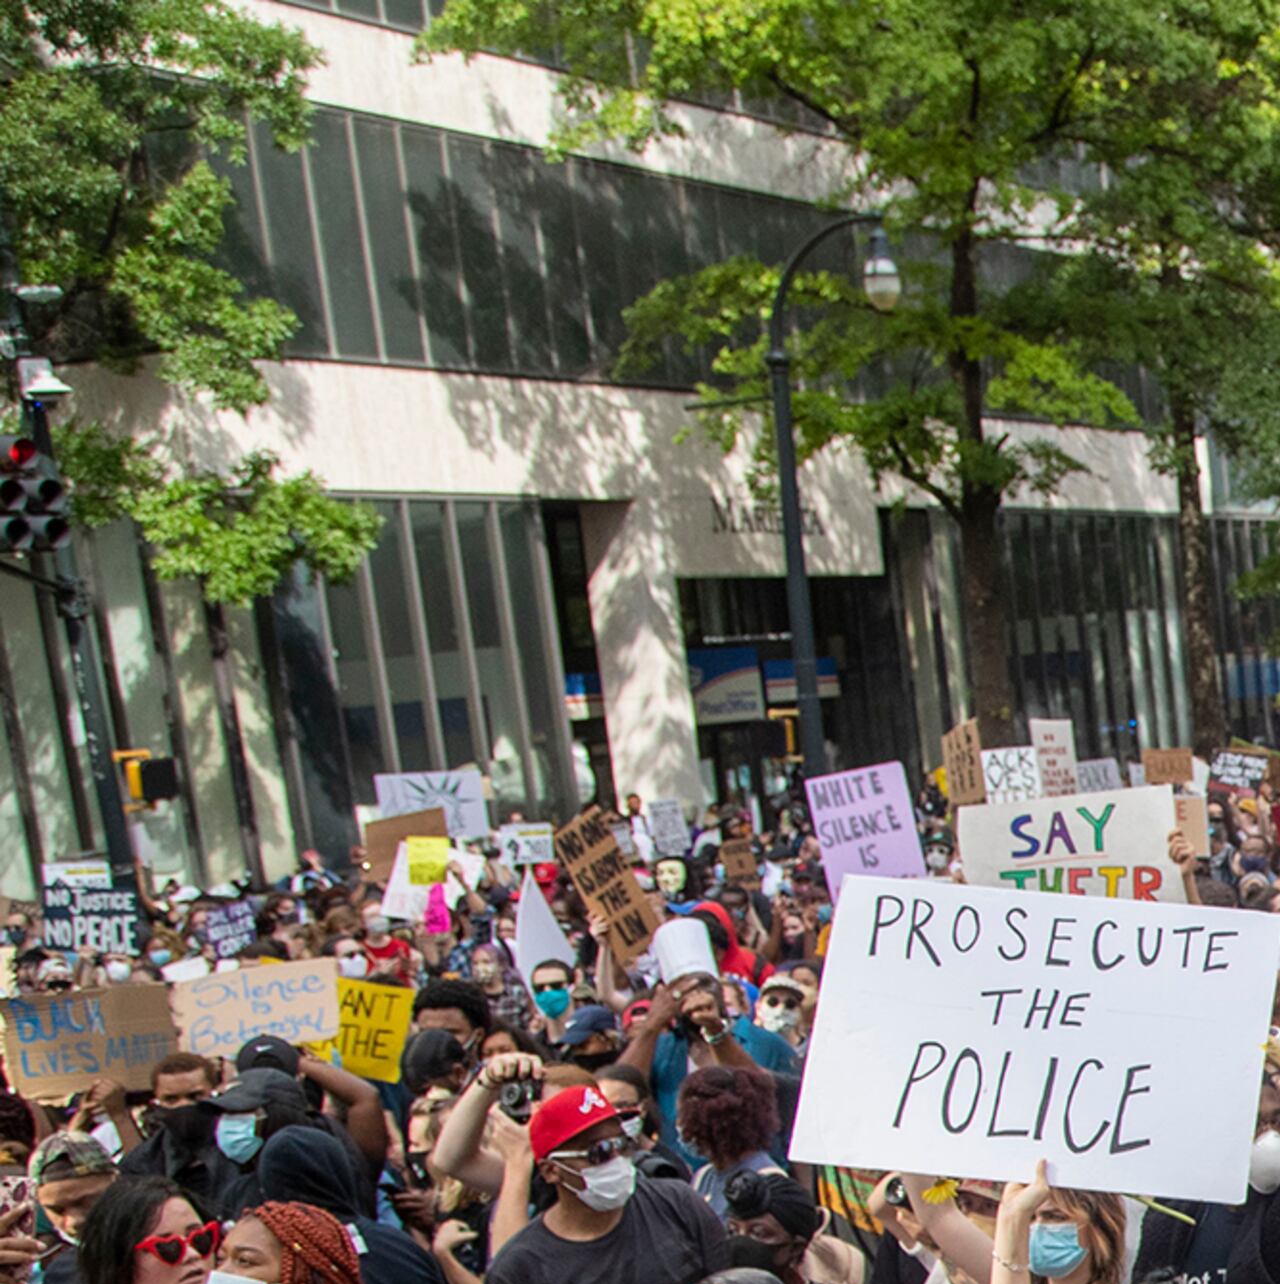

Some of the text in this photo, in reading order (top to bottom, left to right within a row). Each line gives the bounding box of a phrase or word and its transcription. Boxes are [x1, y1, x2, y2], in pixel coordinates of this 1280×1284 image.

[811, 770, 884, 812] WHITE
[818, 804, 902, 849] SILENCE
[1010, 803, 1116, 858] SAY
[557, 830, 585, 865] NO
[860, 844, 879, 868] IS
[45, 888, 71, 907] NO
[575, 869, 597, 897] IS
[597, 879, 631, 917] THE
[1000, 866, 1163, 902] THEIR
[44, 917, 141, 956] NO PEACE
[610, 908, 650, 948] LAW
[869, 895, 1239, 973] PROSECUTE
[190, 972, 326, 1009] Silence
[981, 988, 1091, 1030] THE
[13, 999, 106, 1043] BLACK
[892, 1041, 1151, 1155] POLICE
